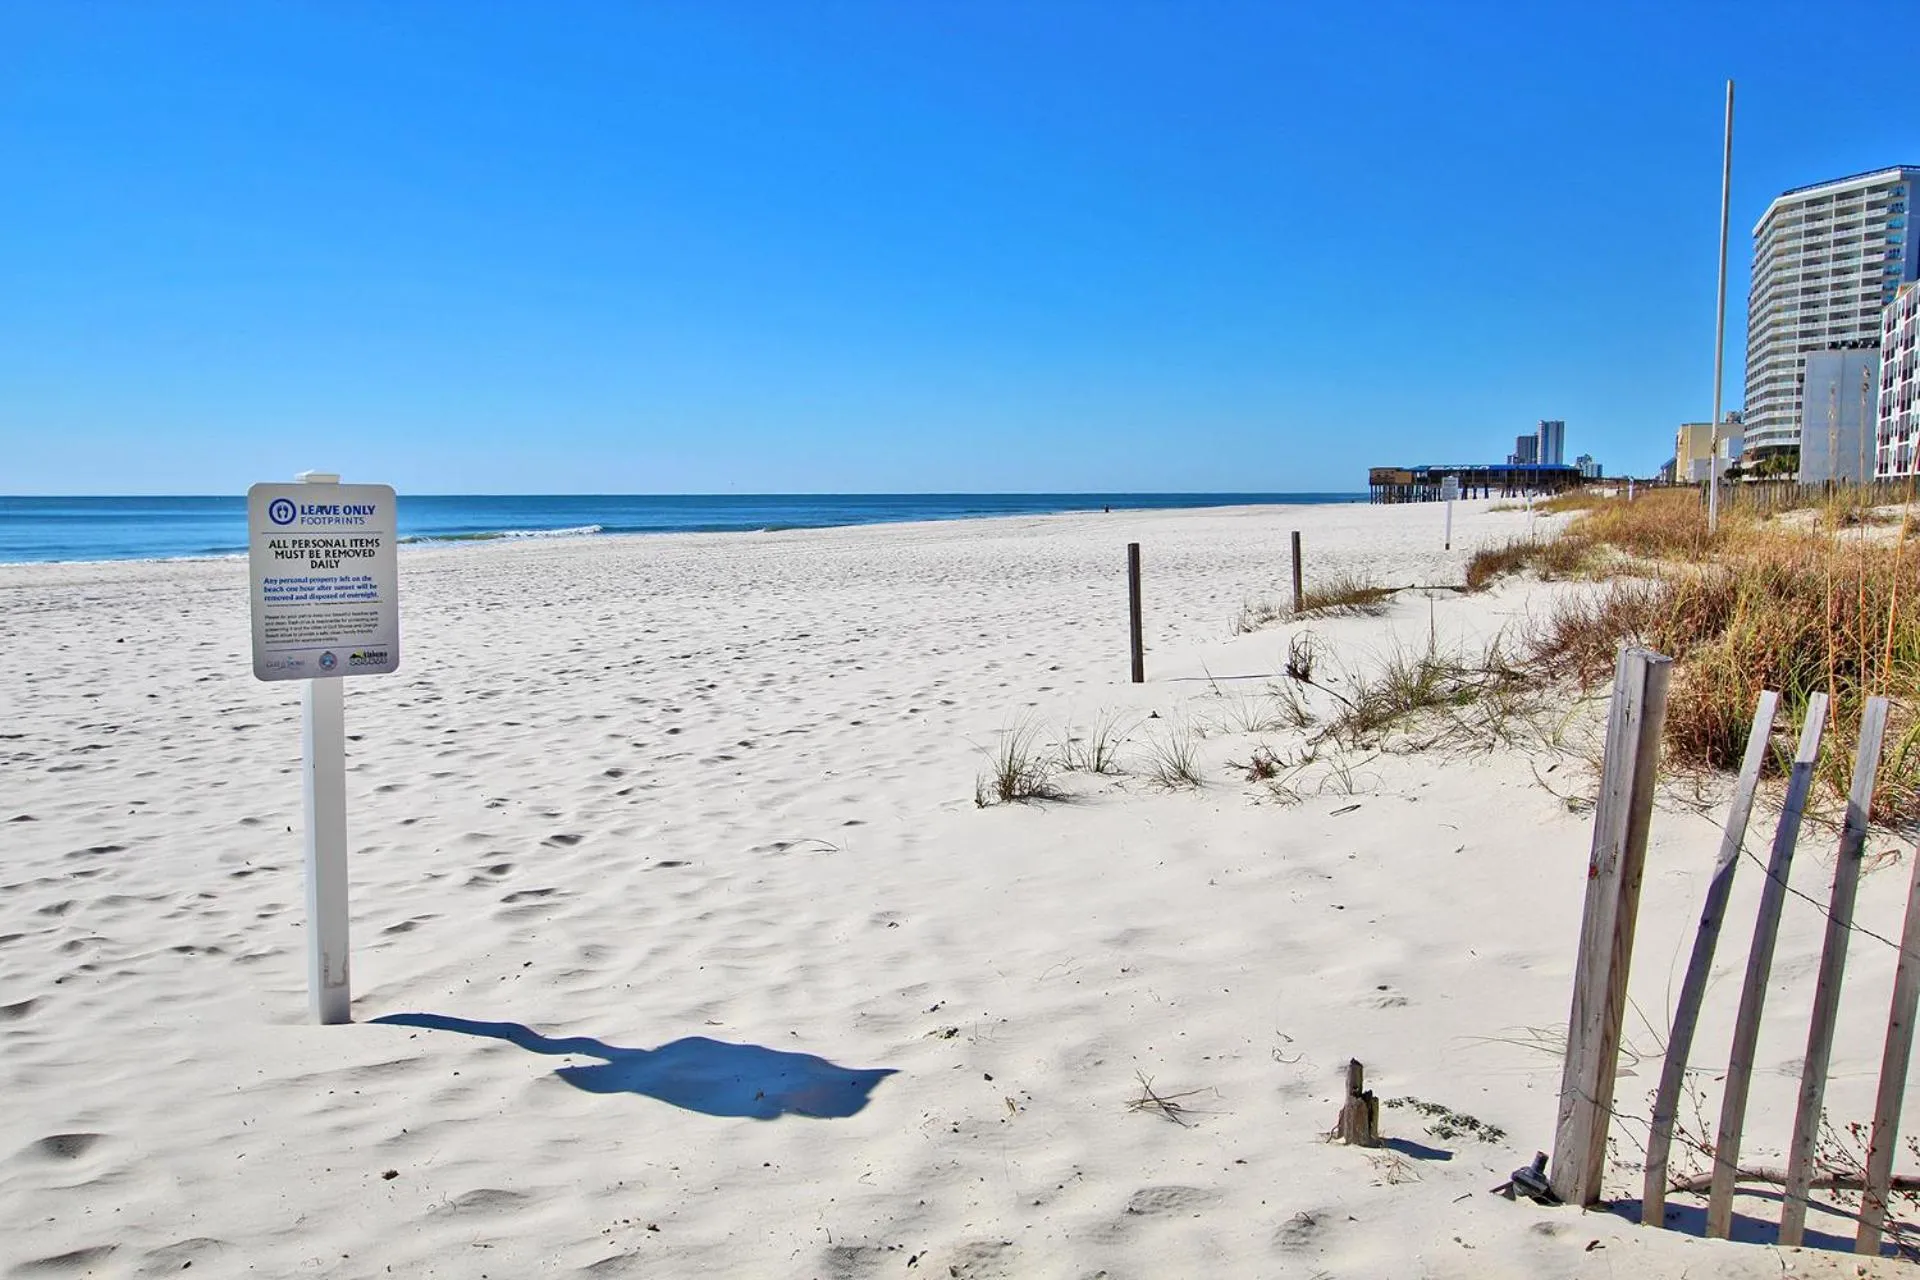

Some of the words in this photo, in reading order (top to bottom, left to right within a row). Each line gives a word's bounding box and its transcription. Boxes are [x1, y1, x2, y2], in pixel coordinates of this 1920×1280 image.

[300, 505, 339, 515] LEAVE
[343, 505, 376, 515] ONLY
[300, 517, 365, 526] FOOTPRINTS
[269, 539, 288, 549] ALL
[292, 539, 347, 549] PERSONAL
[350, 538, 380, 548] ITEMS
[275, 550, 305, 559] MUST
[309, 549, 321, 559] BE
[325, 549, 375, 558] REMOVED
[310, 560, 340, 569] DAILY
[264, 577, 278, 585] Any
[279, 577, 308, 585] personal
[309, 592, 338, 601] disposed
